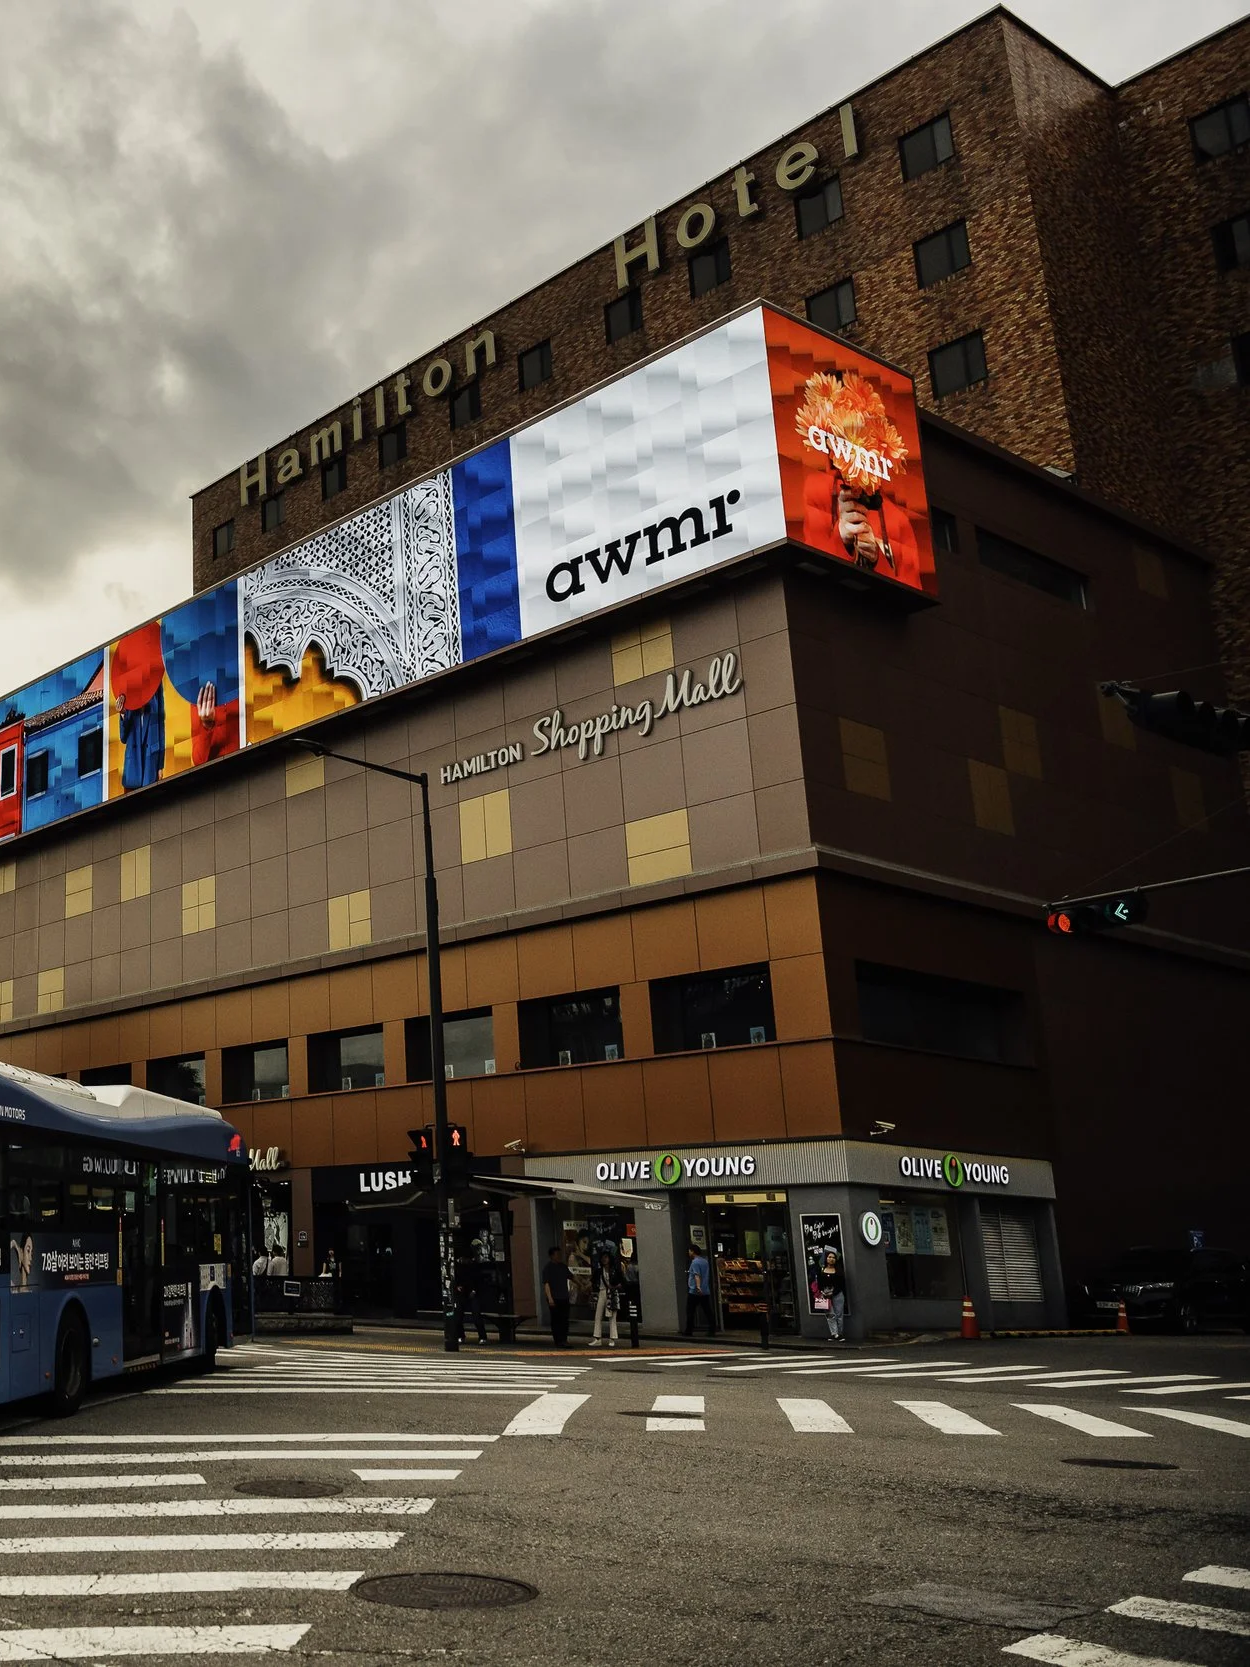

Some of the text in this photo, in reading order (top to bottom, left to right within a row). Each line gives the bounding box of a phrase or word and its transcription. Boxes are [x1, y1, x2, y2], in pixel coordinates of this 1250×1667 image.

[239, 102, 859, 505] Hamilton Hotel
[806, 424, 894, 482] awmr
[546, 489, 741, 602] awmr
[440, 652, 742, 785] HAMILTON Shopping Mall
[4, 1105, 26, 1120] MOTORS
[596, 1155, 755, 1182] OLIVE YOUNG
[901, 1156, 1009, 1186] OLIVE YOUNG
[69, 1253, 84, 1271] 보이는
[84, 1252, 95, 1270] 동안
